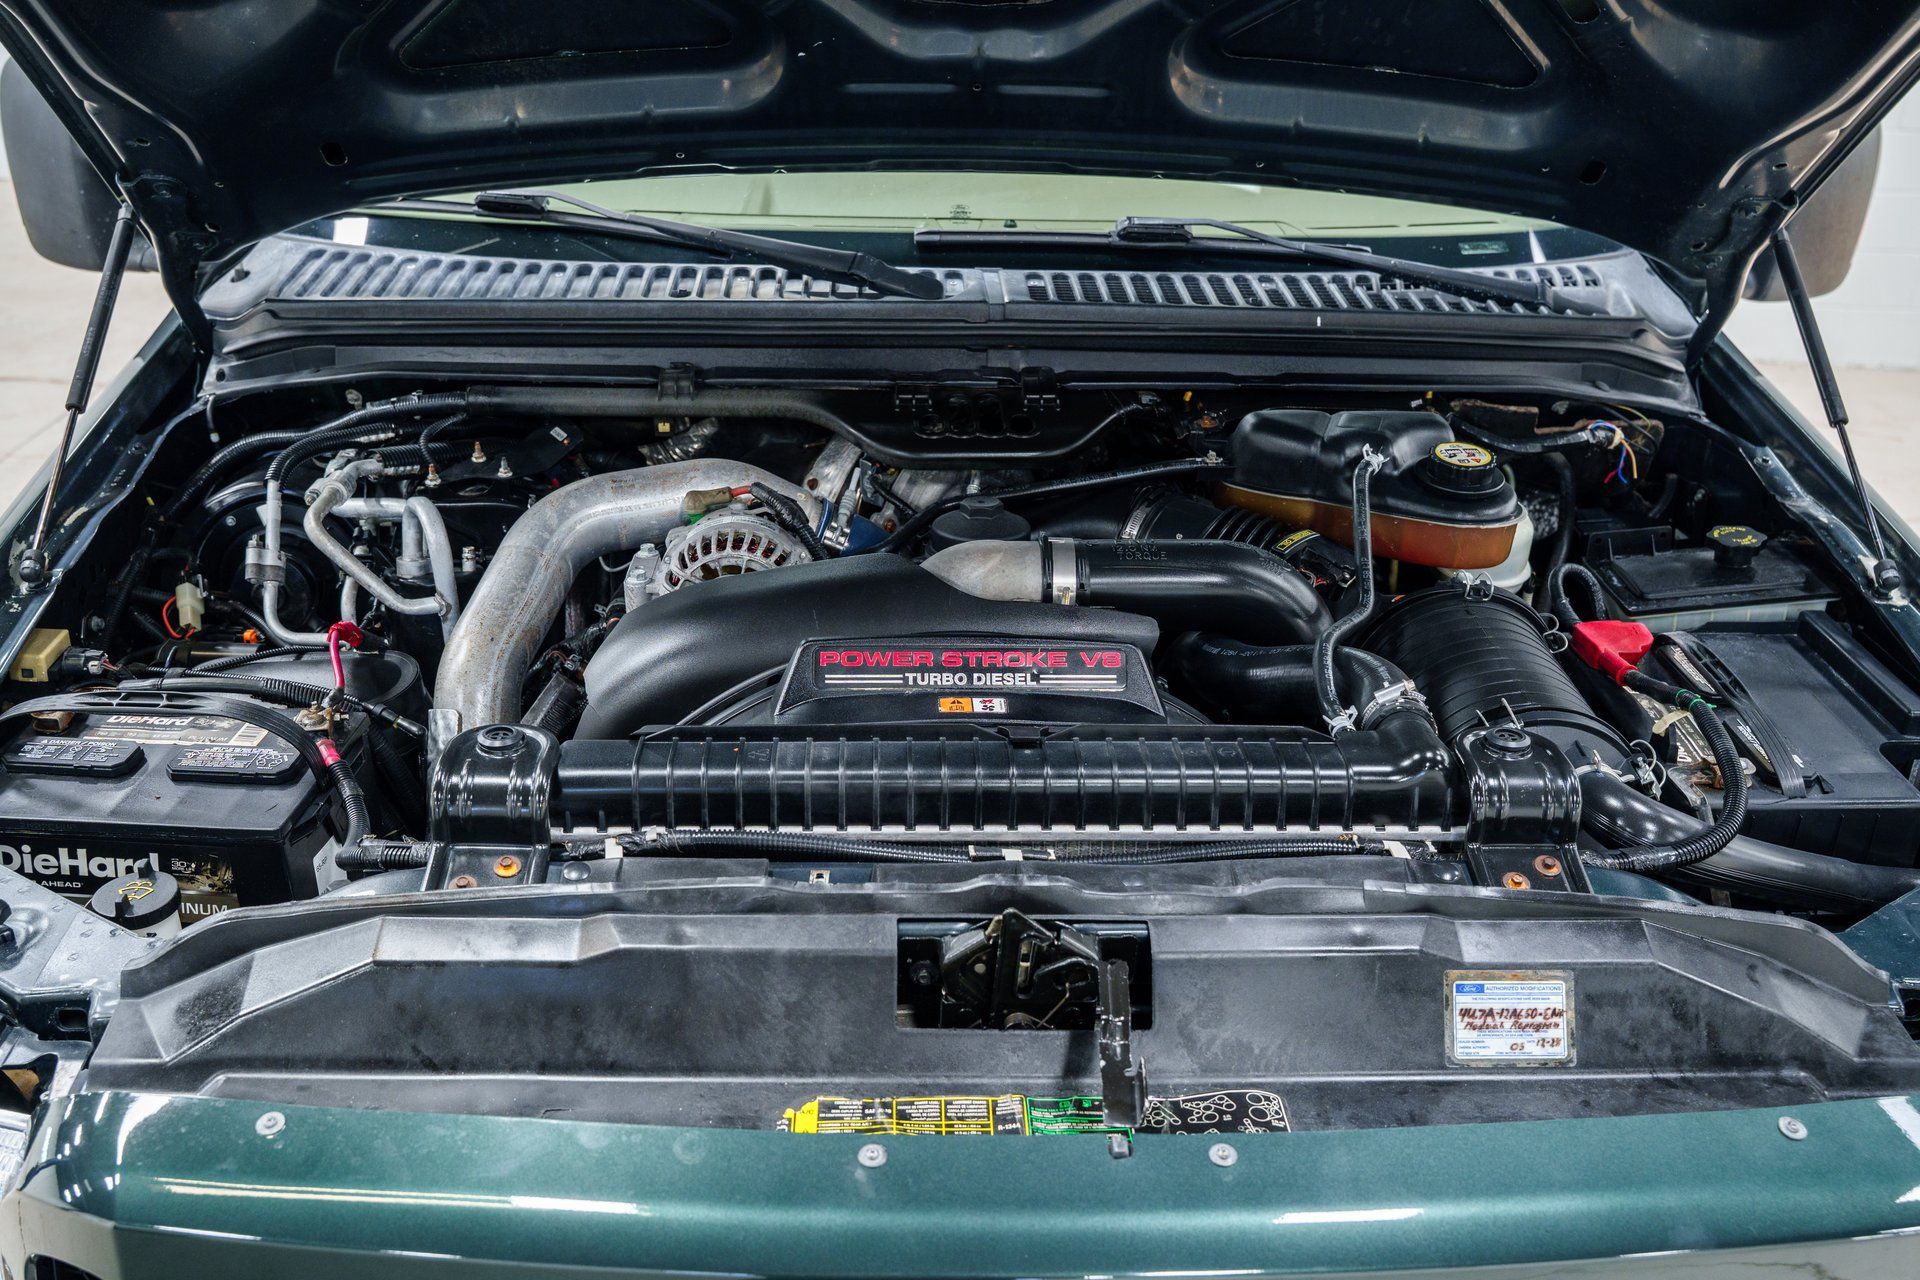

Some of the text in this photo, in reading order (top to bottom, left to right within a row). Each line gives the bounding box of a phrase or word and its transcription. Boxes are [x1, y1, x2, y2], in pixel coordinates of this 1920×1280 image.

[1116, 551, 1168, 560] TORQUE
[819, 651, 1122, 668] POWER STROKE V8
[905, 673, 1037, 686] TURBO DIESEL
[107, 715, 193, 726] DieHard
[41, 880, 82, 888] AHEAD
